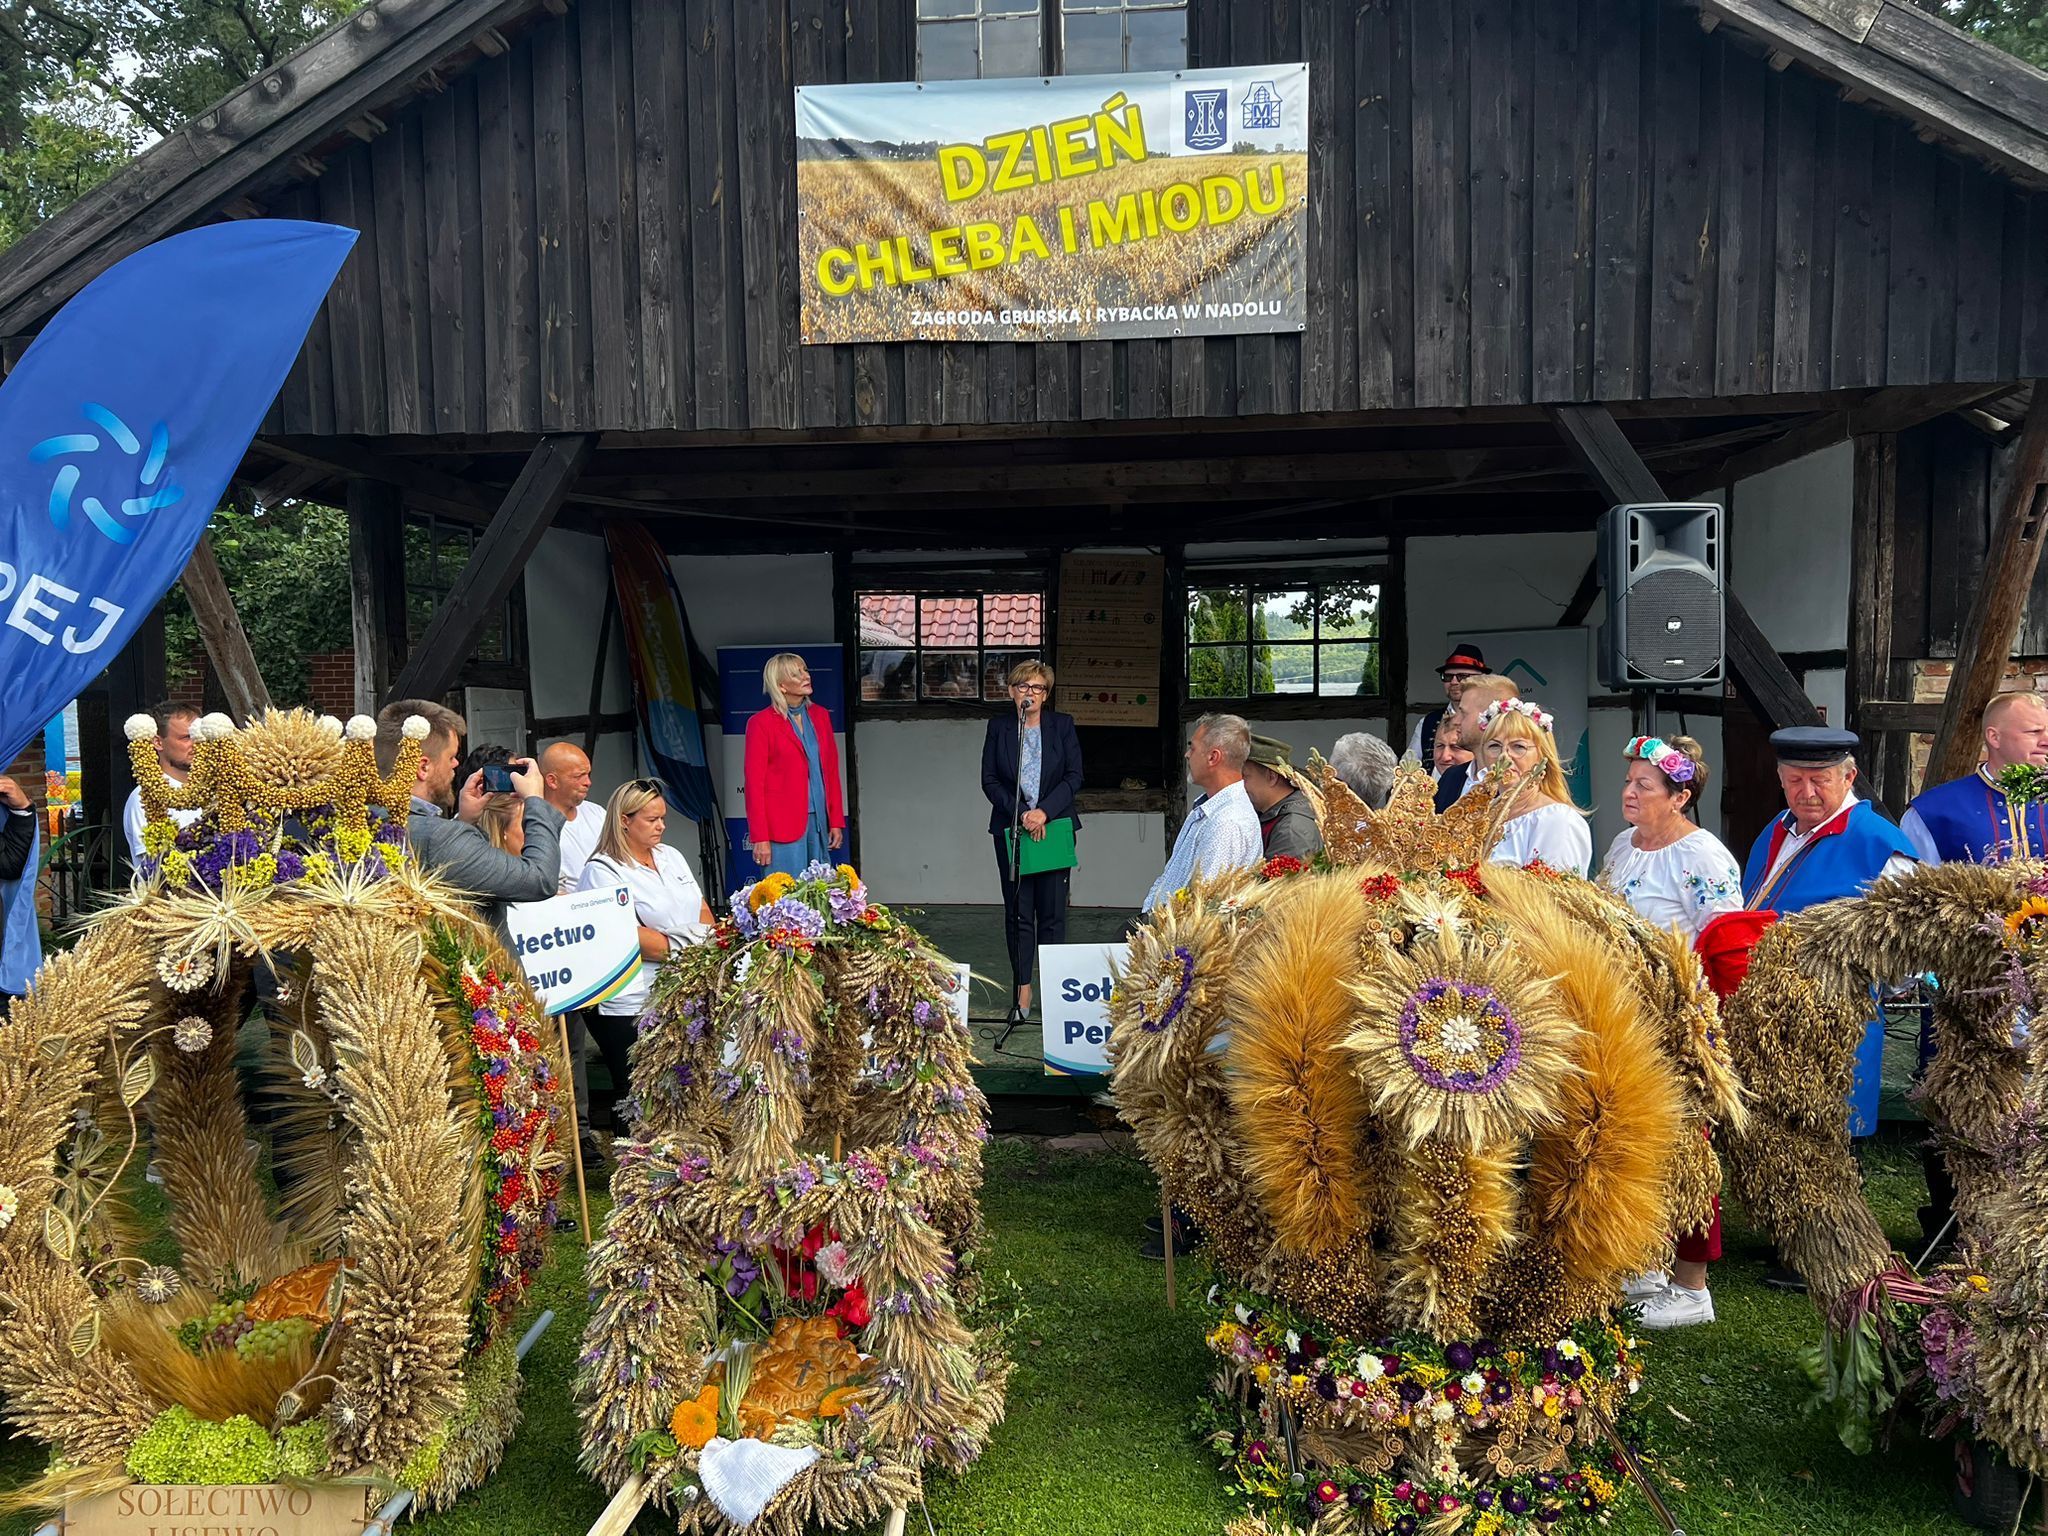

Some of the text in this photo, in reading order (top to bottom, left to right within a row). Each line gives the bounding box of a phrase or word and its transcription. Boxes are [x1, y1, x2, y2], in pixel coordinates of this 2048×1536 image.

[1254, 104, 1271, 117] M
[938, 90, 1148, 202] DZIEŃ
[815, 163, 1288, 297] CHLEBA I MIODU
[911, 299, 1282, 326] ZAGRODA GBURSKA I RYBACKA W NADOLU
[117, 1487, 313, 1517] SOŁECTWO
